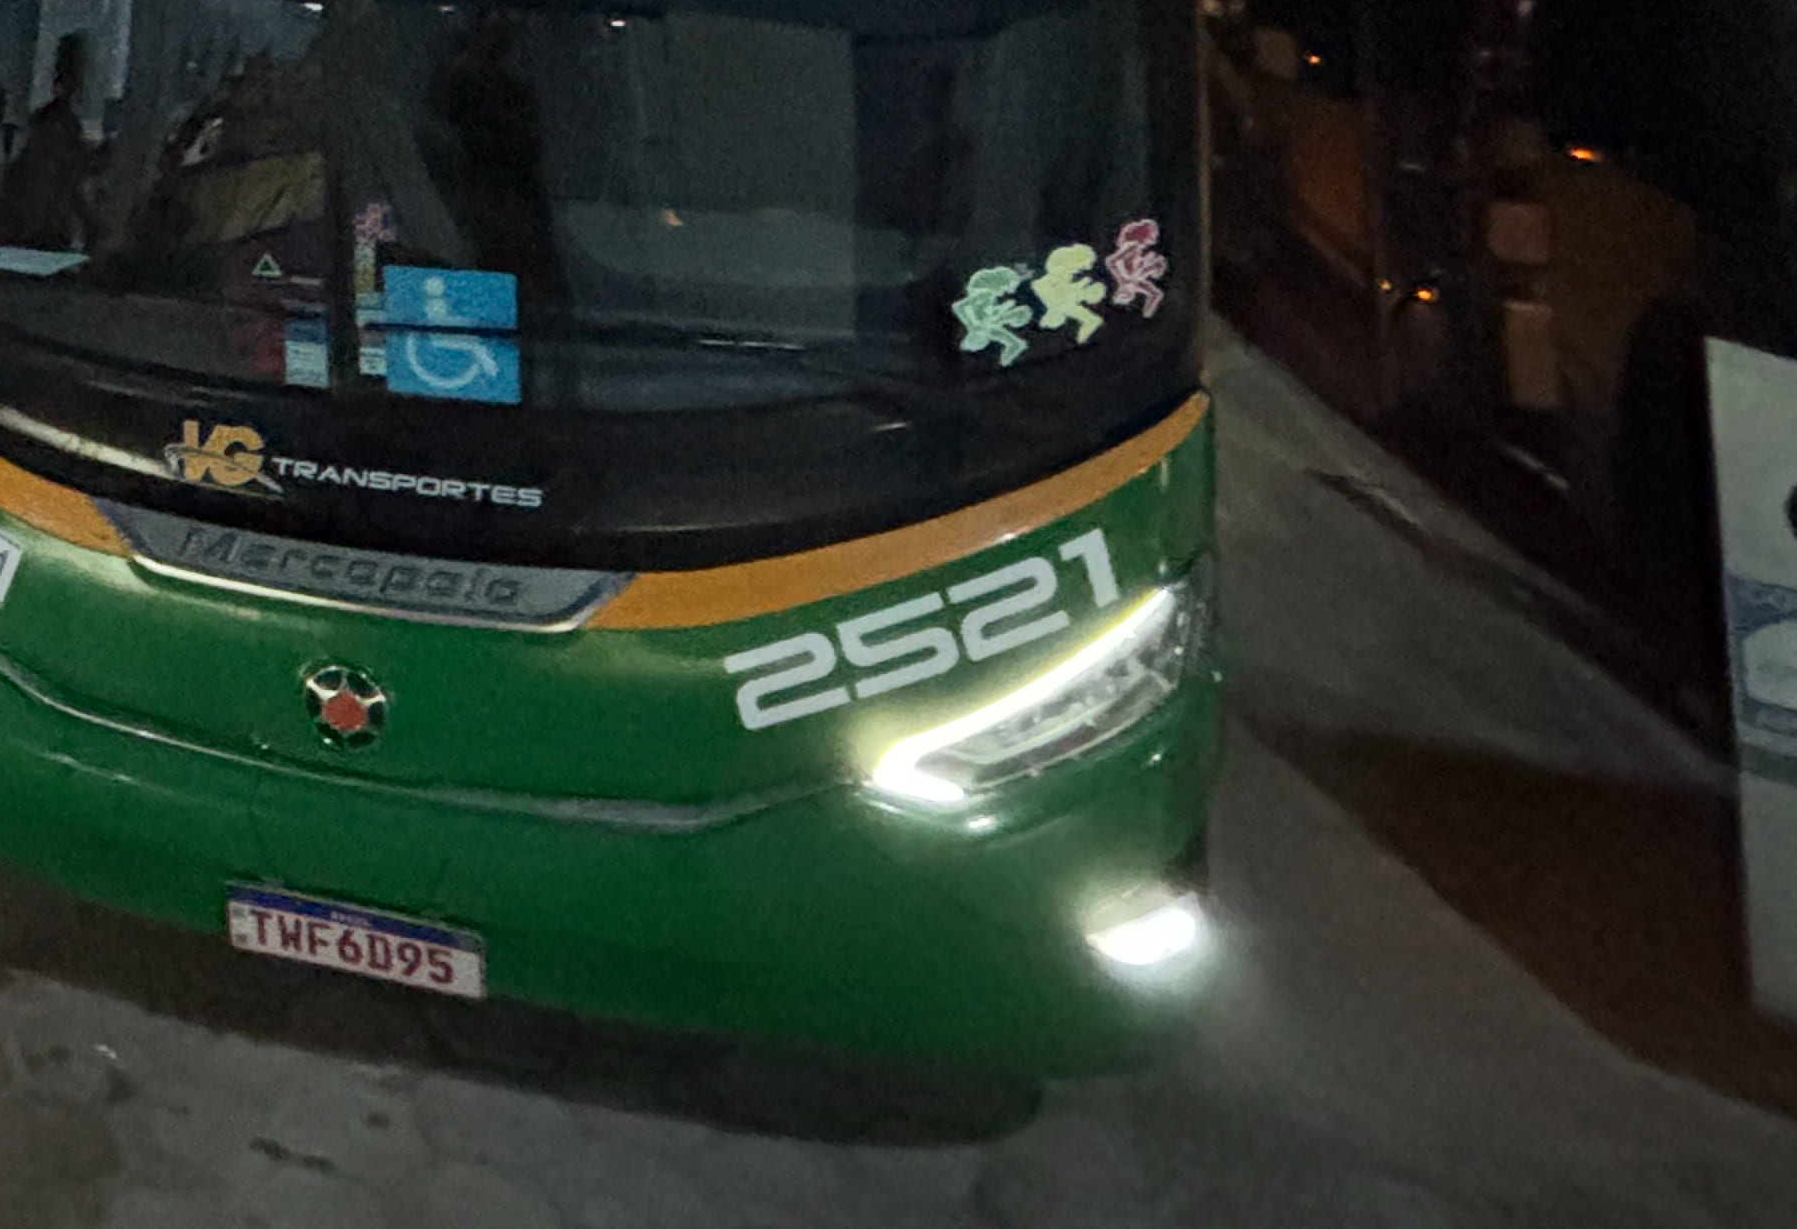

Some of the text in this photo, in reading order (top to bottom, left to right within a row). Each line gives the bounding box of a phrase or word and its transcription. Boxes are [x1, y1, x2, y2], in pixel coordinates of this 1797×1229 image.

[271, 456, 544, 508] TRANSPORTES
[723, 527, 1121, 732] 2521
[248, 910, 455, 984] TWF6D95
